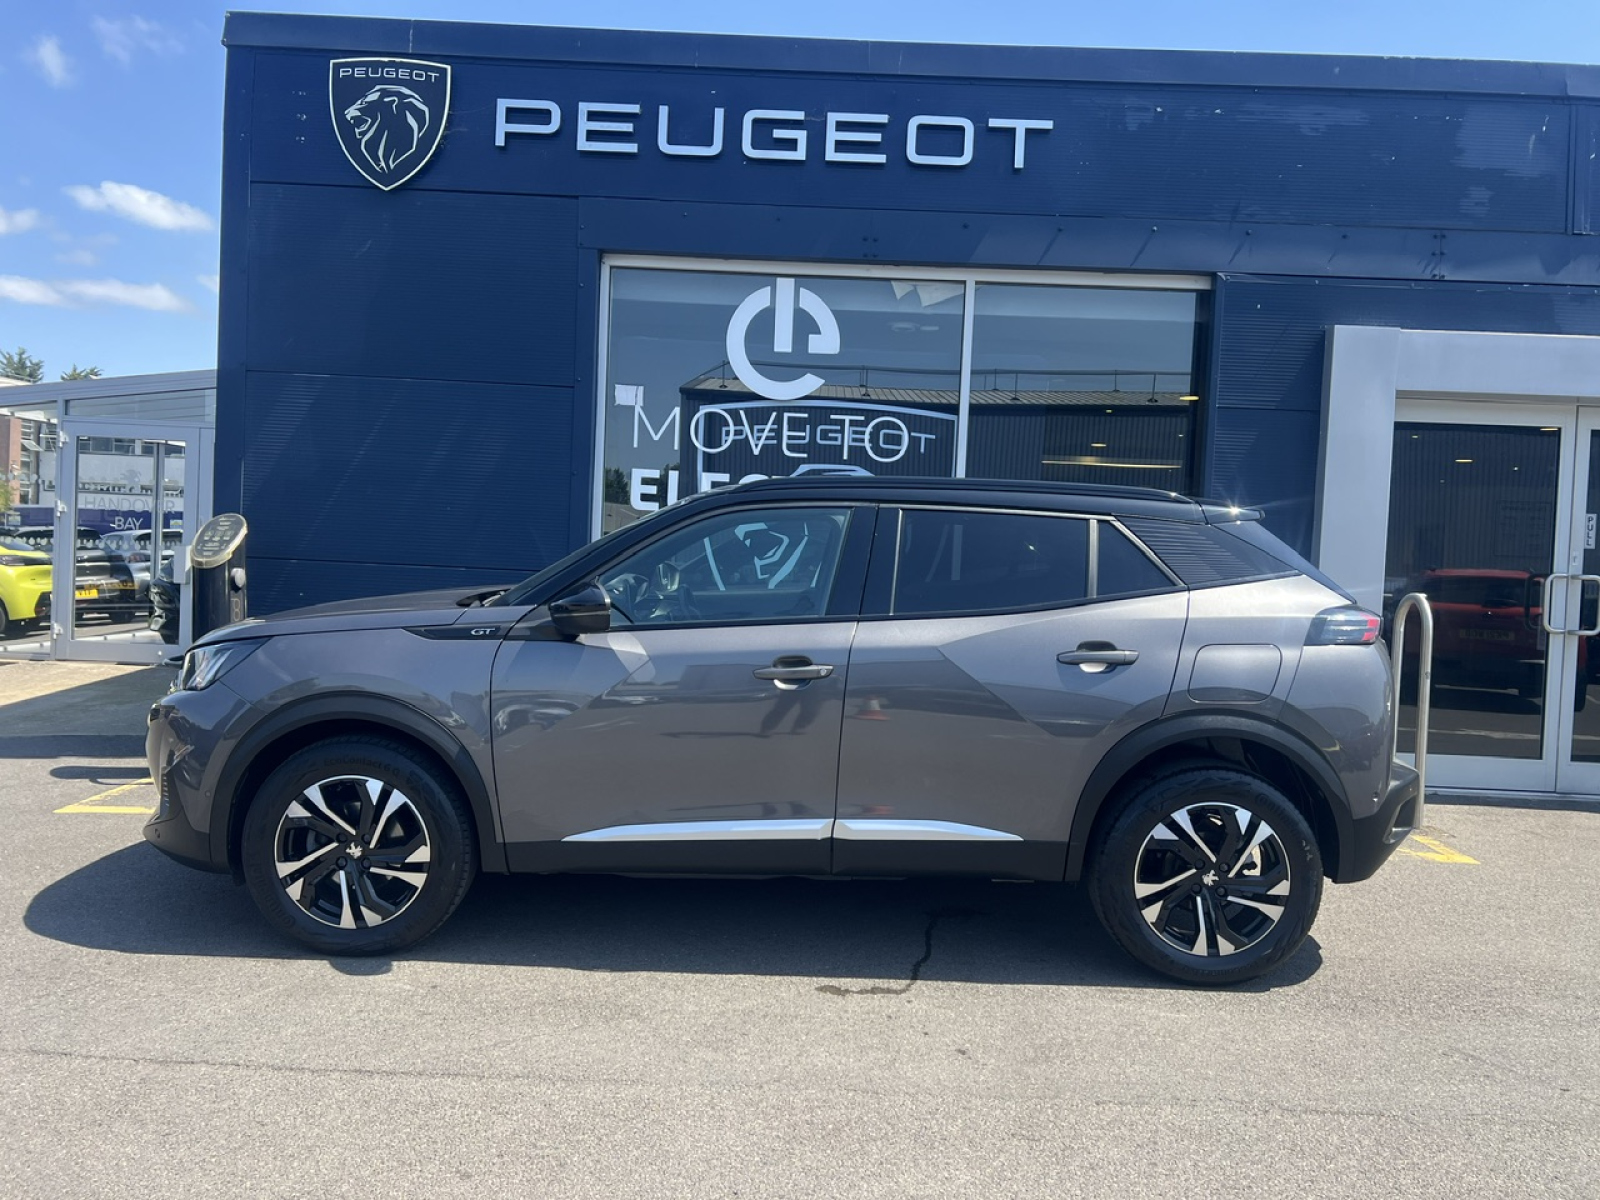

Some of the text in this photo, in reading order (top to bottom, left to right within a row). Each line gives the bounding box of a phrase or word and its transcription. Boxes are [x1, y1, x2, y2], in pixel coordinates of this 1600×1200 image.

[339, 67, 439, 82] PEUGEOT
[495, 98, 1054, 170] PEUGEOT
[633, 406, 909, 462] MOVE TO
[114, 516, 143, 530] BAY
[1585, 515, 1595, 547] PULL
[470, 628, 495, 636] GT
